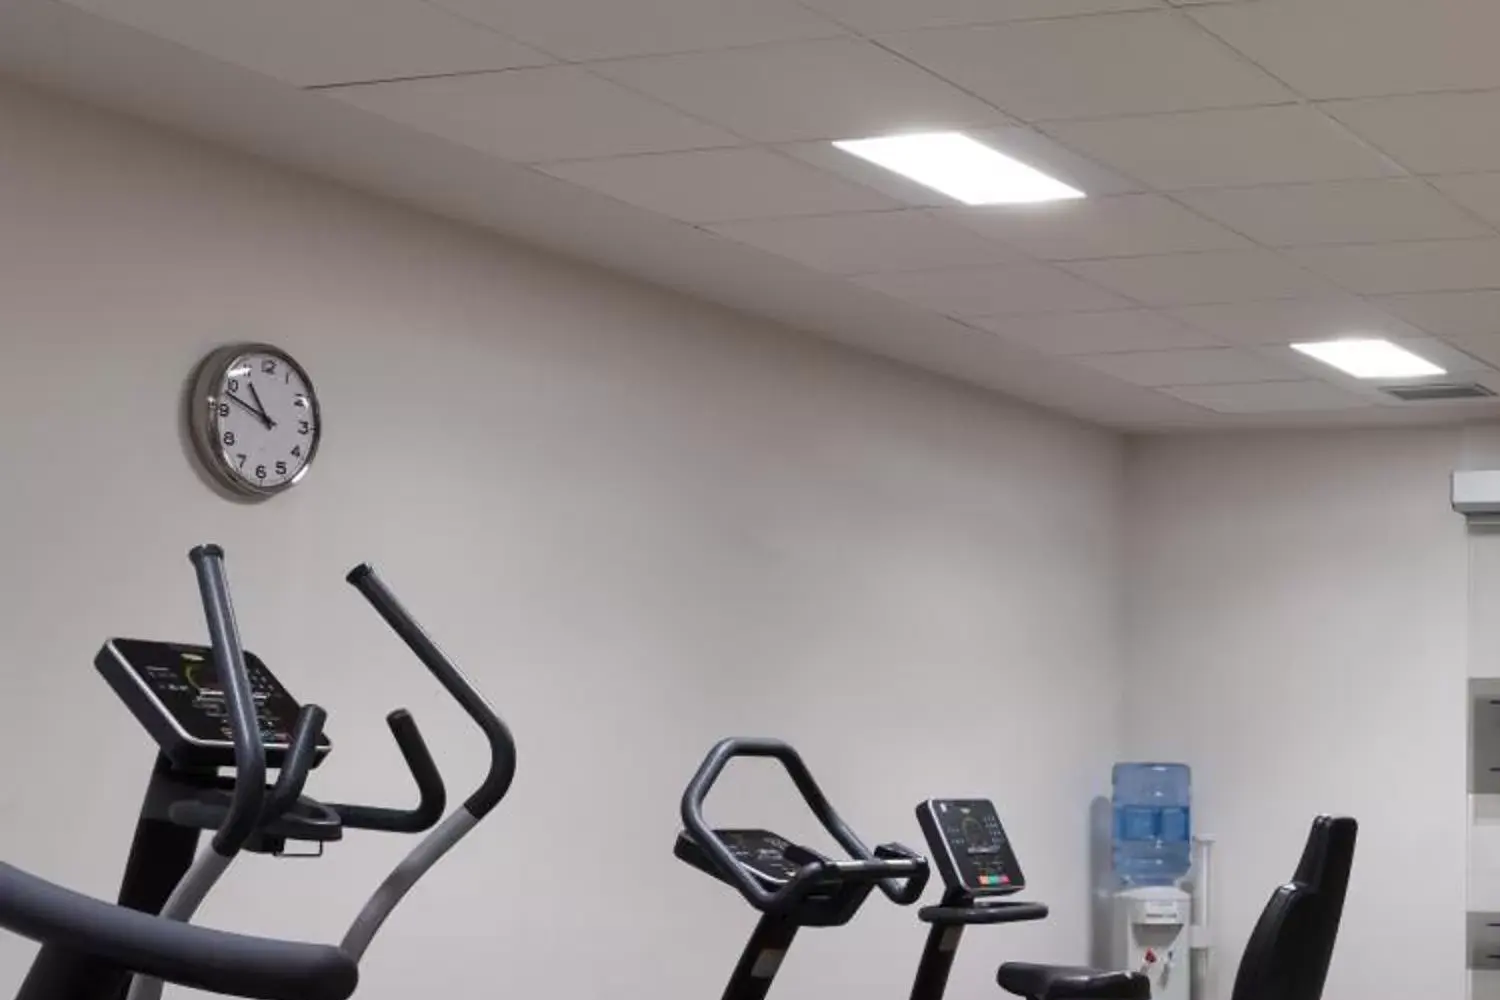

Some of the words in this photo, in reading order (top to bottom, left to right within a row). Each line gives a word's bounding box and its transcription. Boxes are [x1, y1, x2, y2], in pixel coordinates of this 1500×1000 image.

[298, 420, 309, 435] 3
[223, 431, 235, 446] 8
[290, 445, 300, 458] 4
[236, 453, 247, 468] 7
[255, 465, 267, 479] 6
[275, 461, 287, 475] 5
